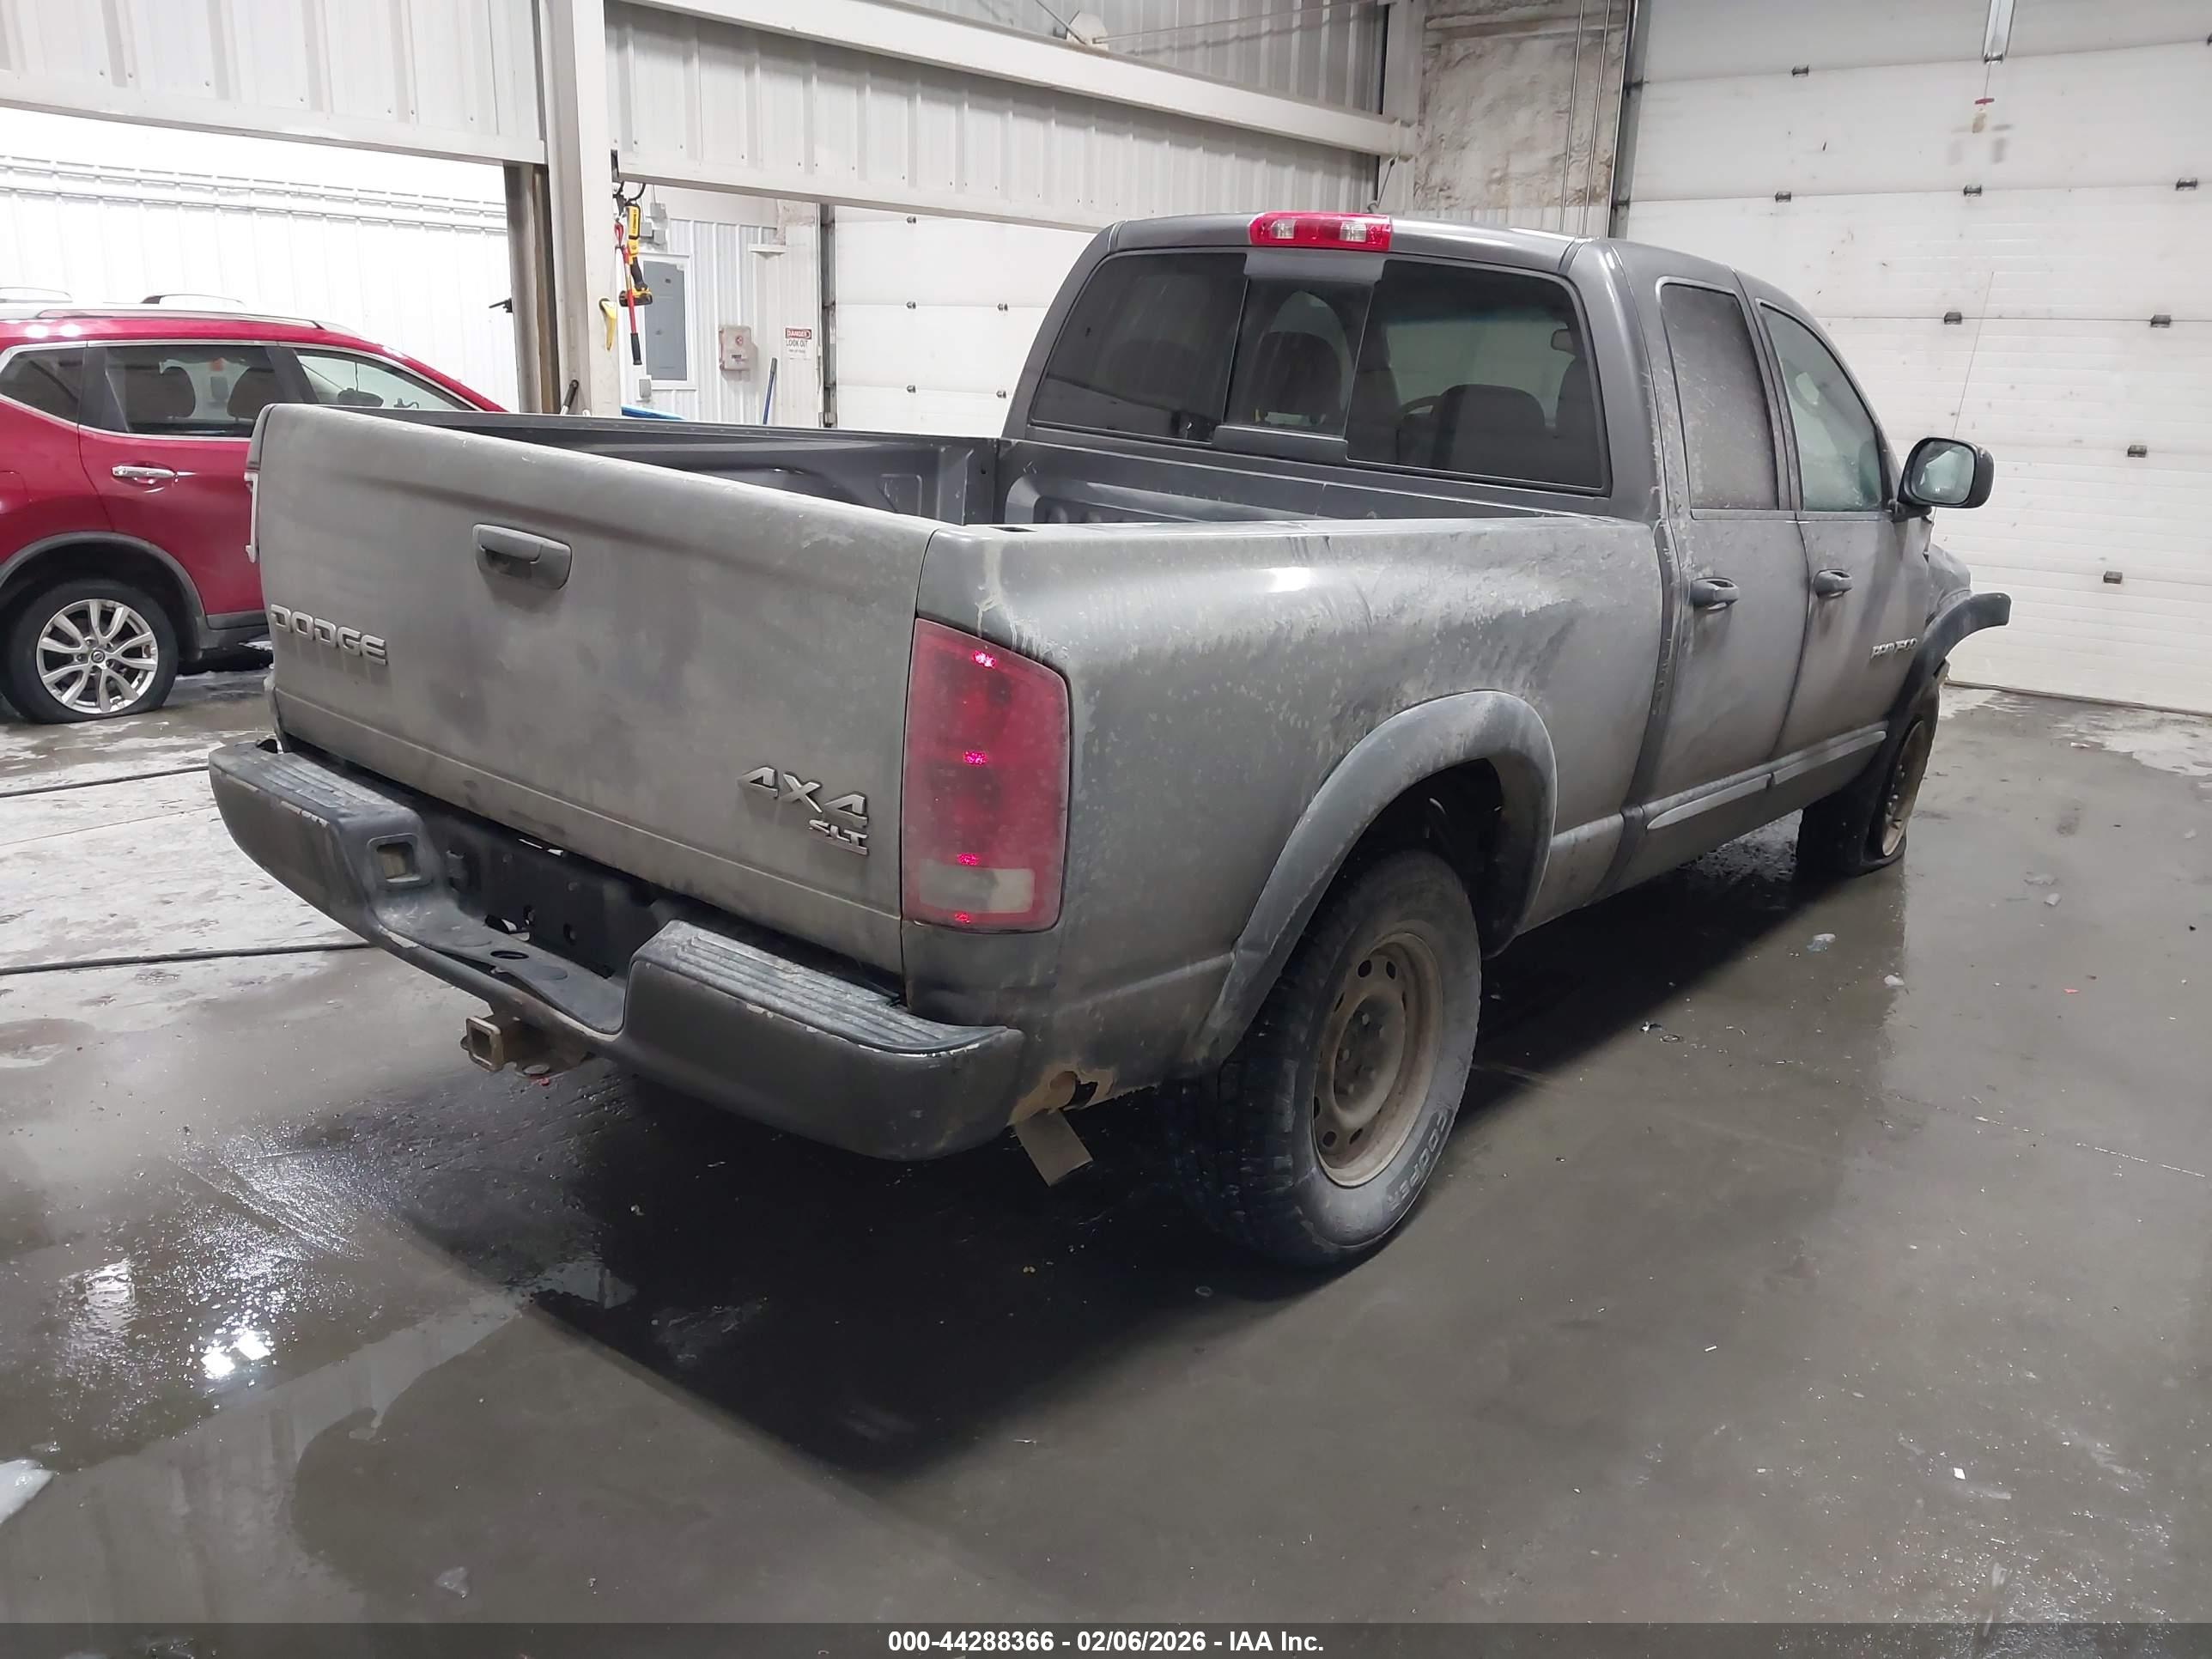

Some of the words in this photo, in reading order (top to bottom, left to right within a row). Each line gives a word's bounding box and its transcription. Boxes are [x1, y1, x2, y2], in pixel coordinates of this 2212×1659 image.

[787, 330, 807, 338] DANGER
[270, 604, 388, 665] DODGE
[808, 818, 869, 851] SLT
[1387, 1112, 1449, 1212] COOPER
